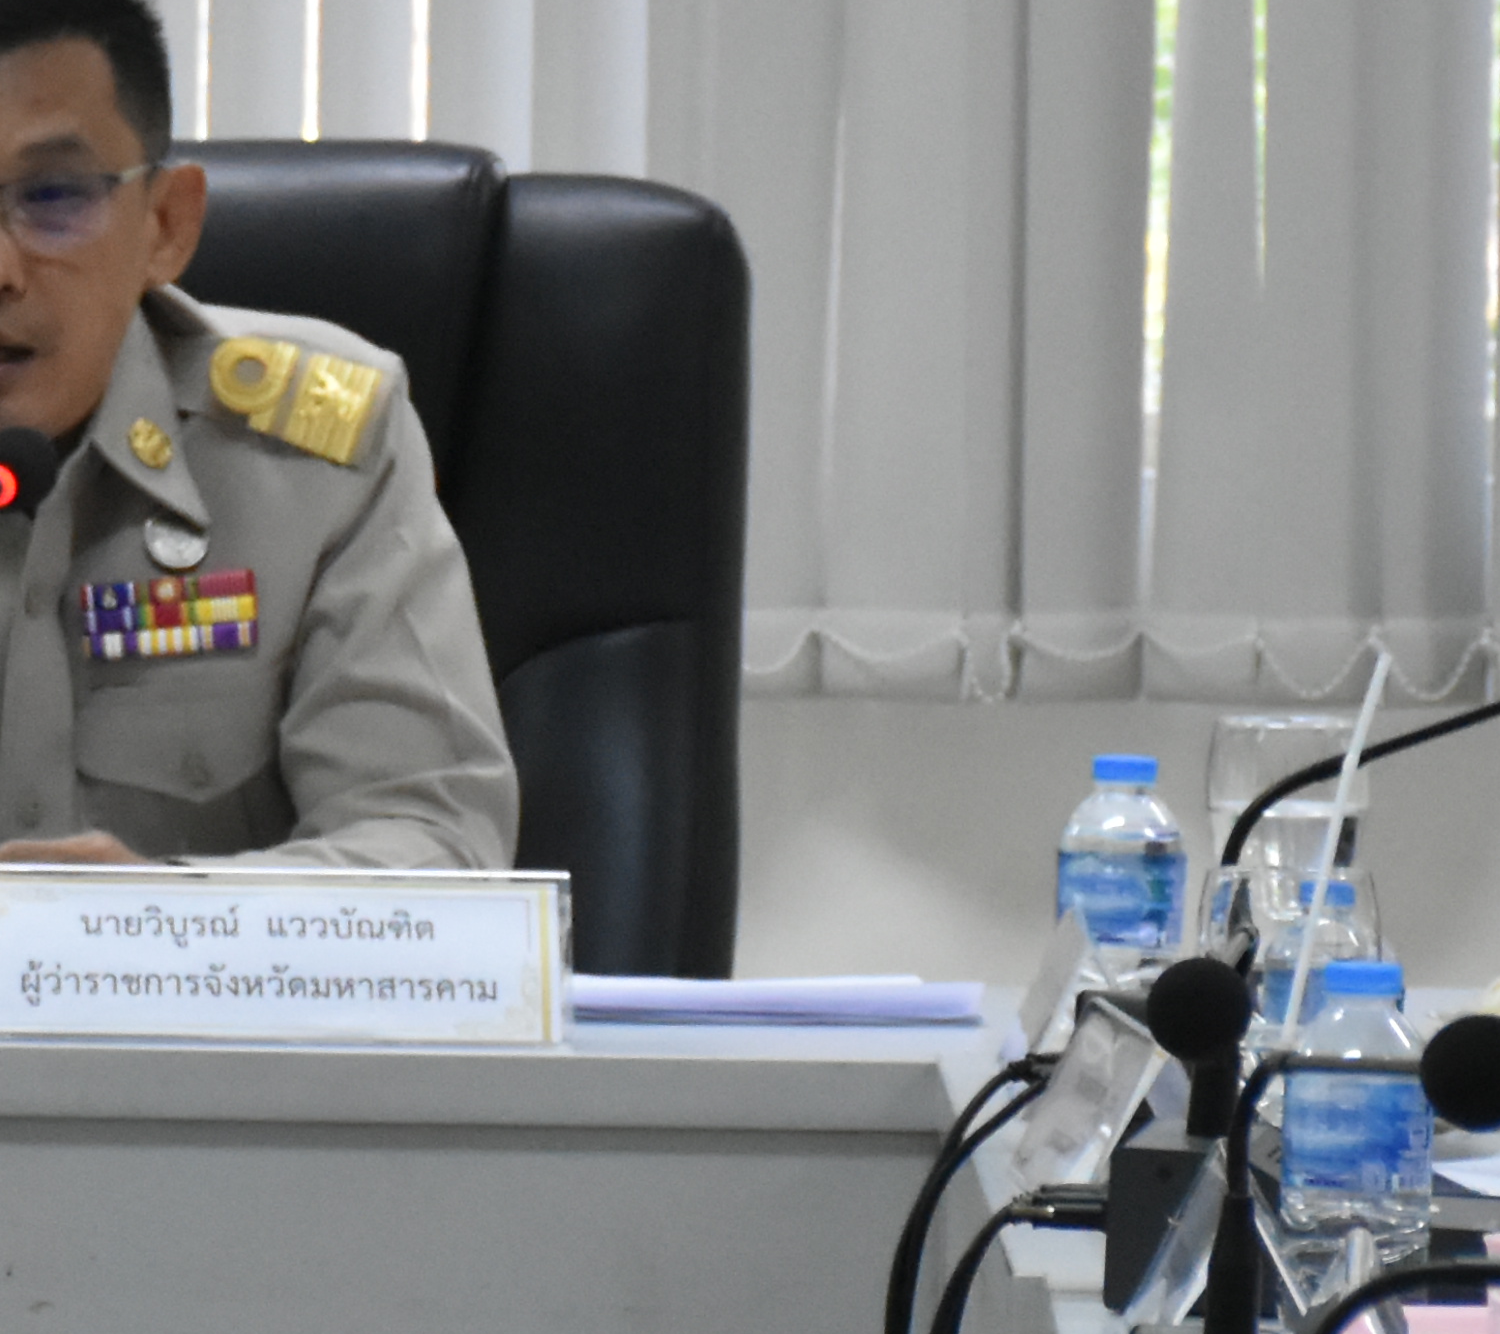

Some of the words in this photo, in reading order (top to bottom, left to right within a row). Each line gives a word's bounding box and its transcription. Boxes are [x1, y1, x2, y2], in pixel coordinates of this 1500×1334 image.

[81, 905, 240, 949] นายวิบูรณ์
[266, 908, 436, 942] แววบัณฑิต
[19, 960, 499, 1007] ผู้ว่าราชการจังหวัดมหาสารคาม
